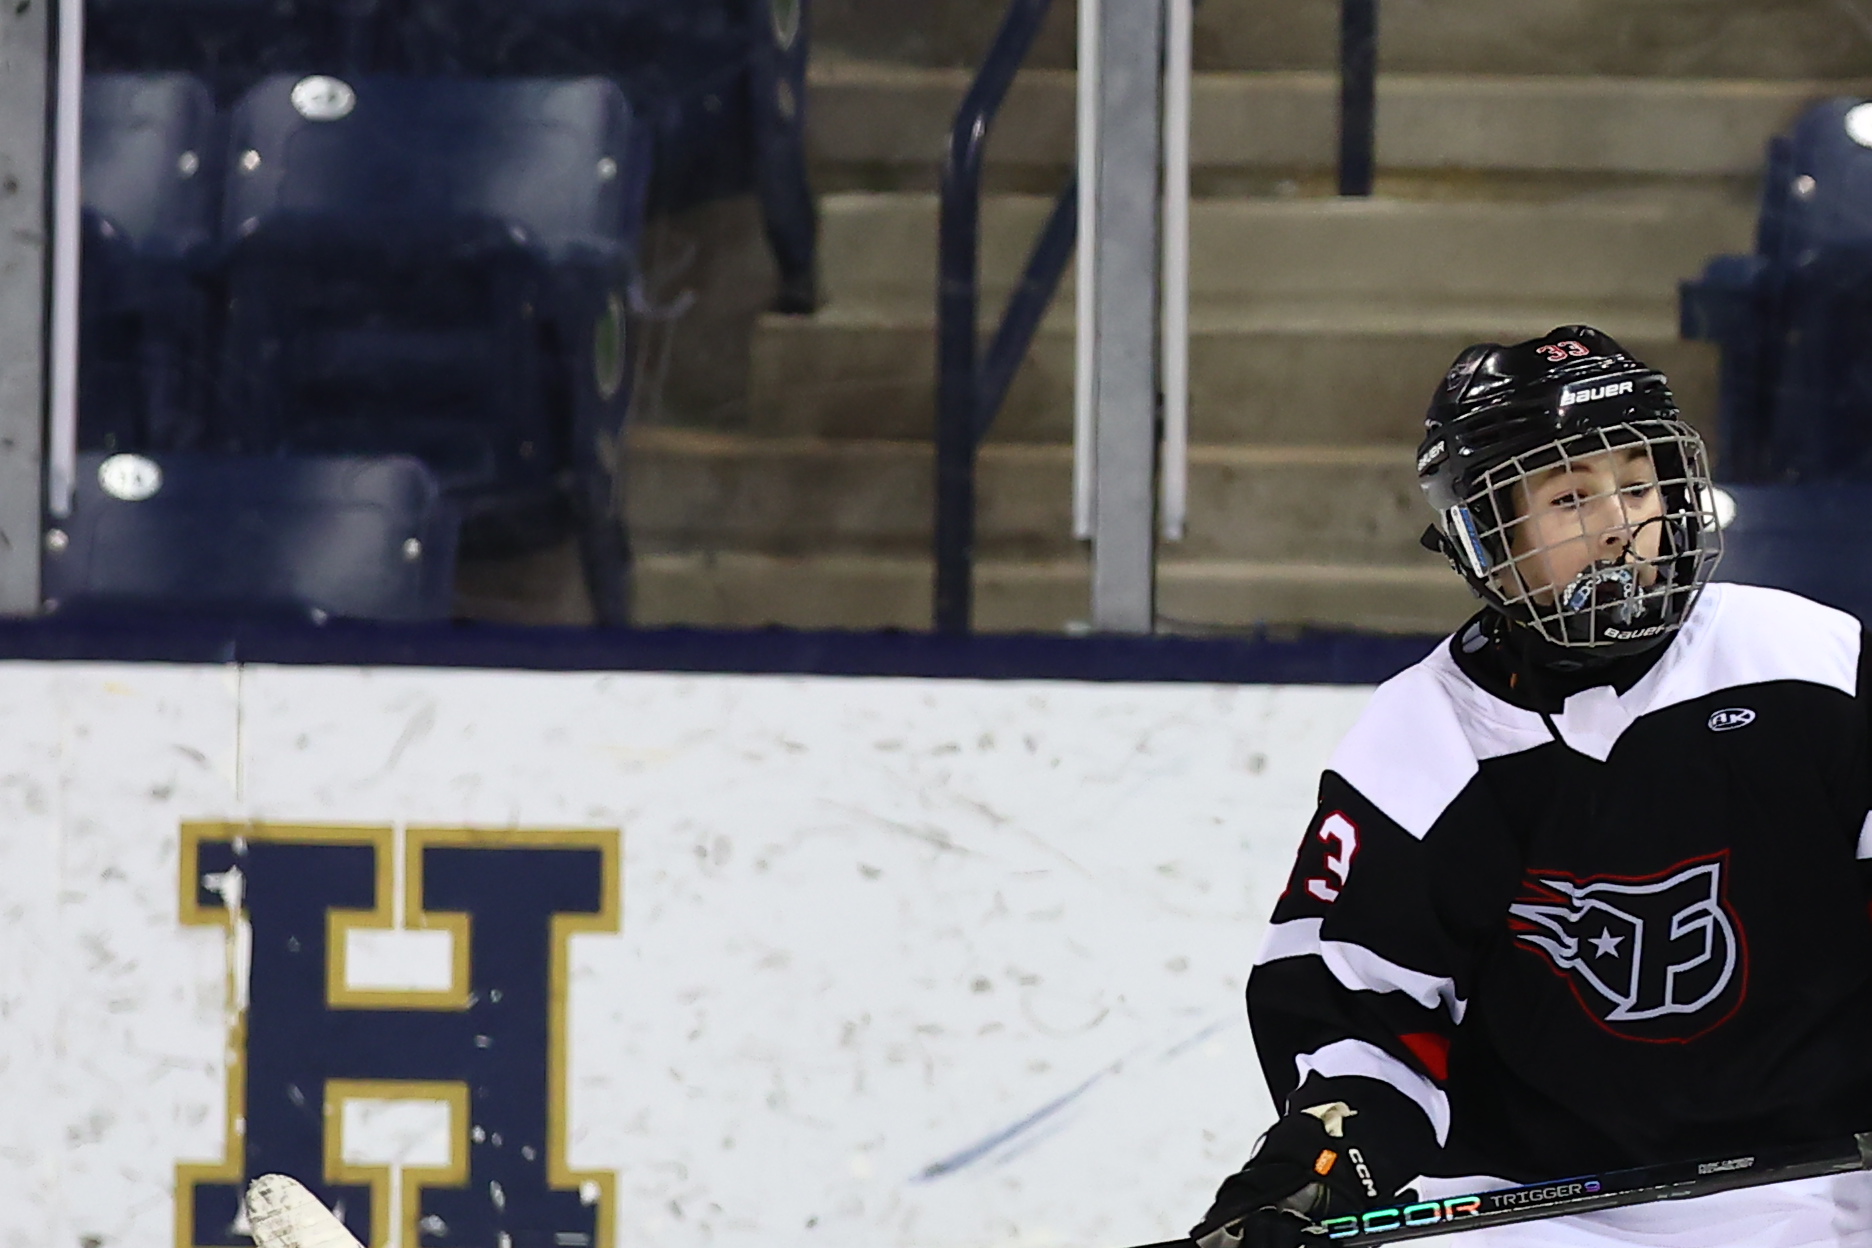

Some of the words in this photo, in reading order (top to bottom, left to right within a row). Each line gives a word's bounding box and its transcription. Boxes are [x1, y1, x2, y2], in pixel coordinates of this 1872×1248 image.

[1536, 341, 1590, 362] 33
[1560, 381, 1633, 407] BAUER
[1348, 1148, 1378, 1197] CCM
